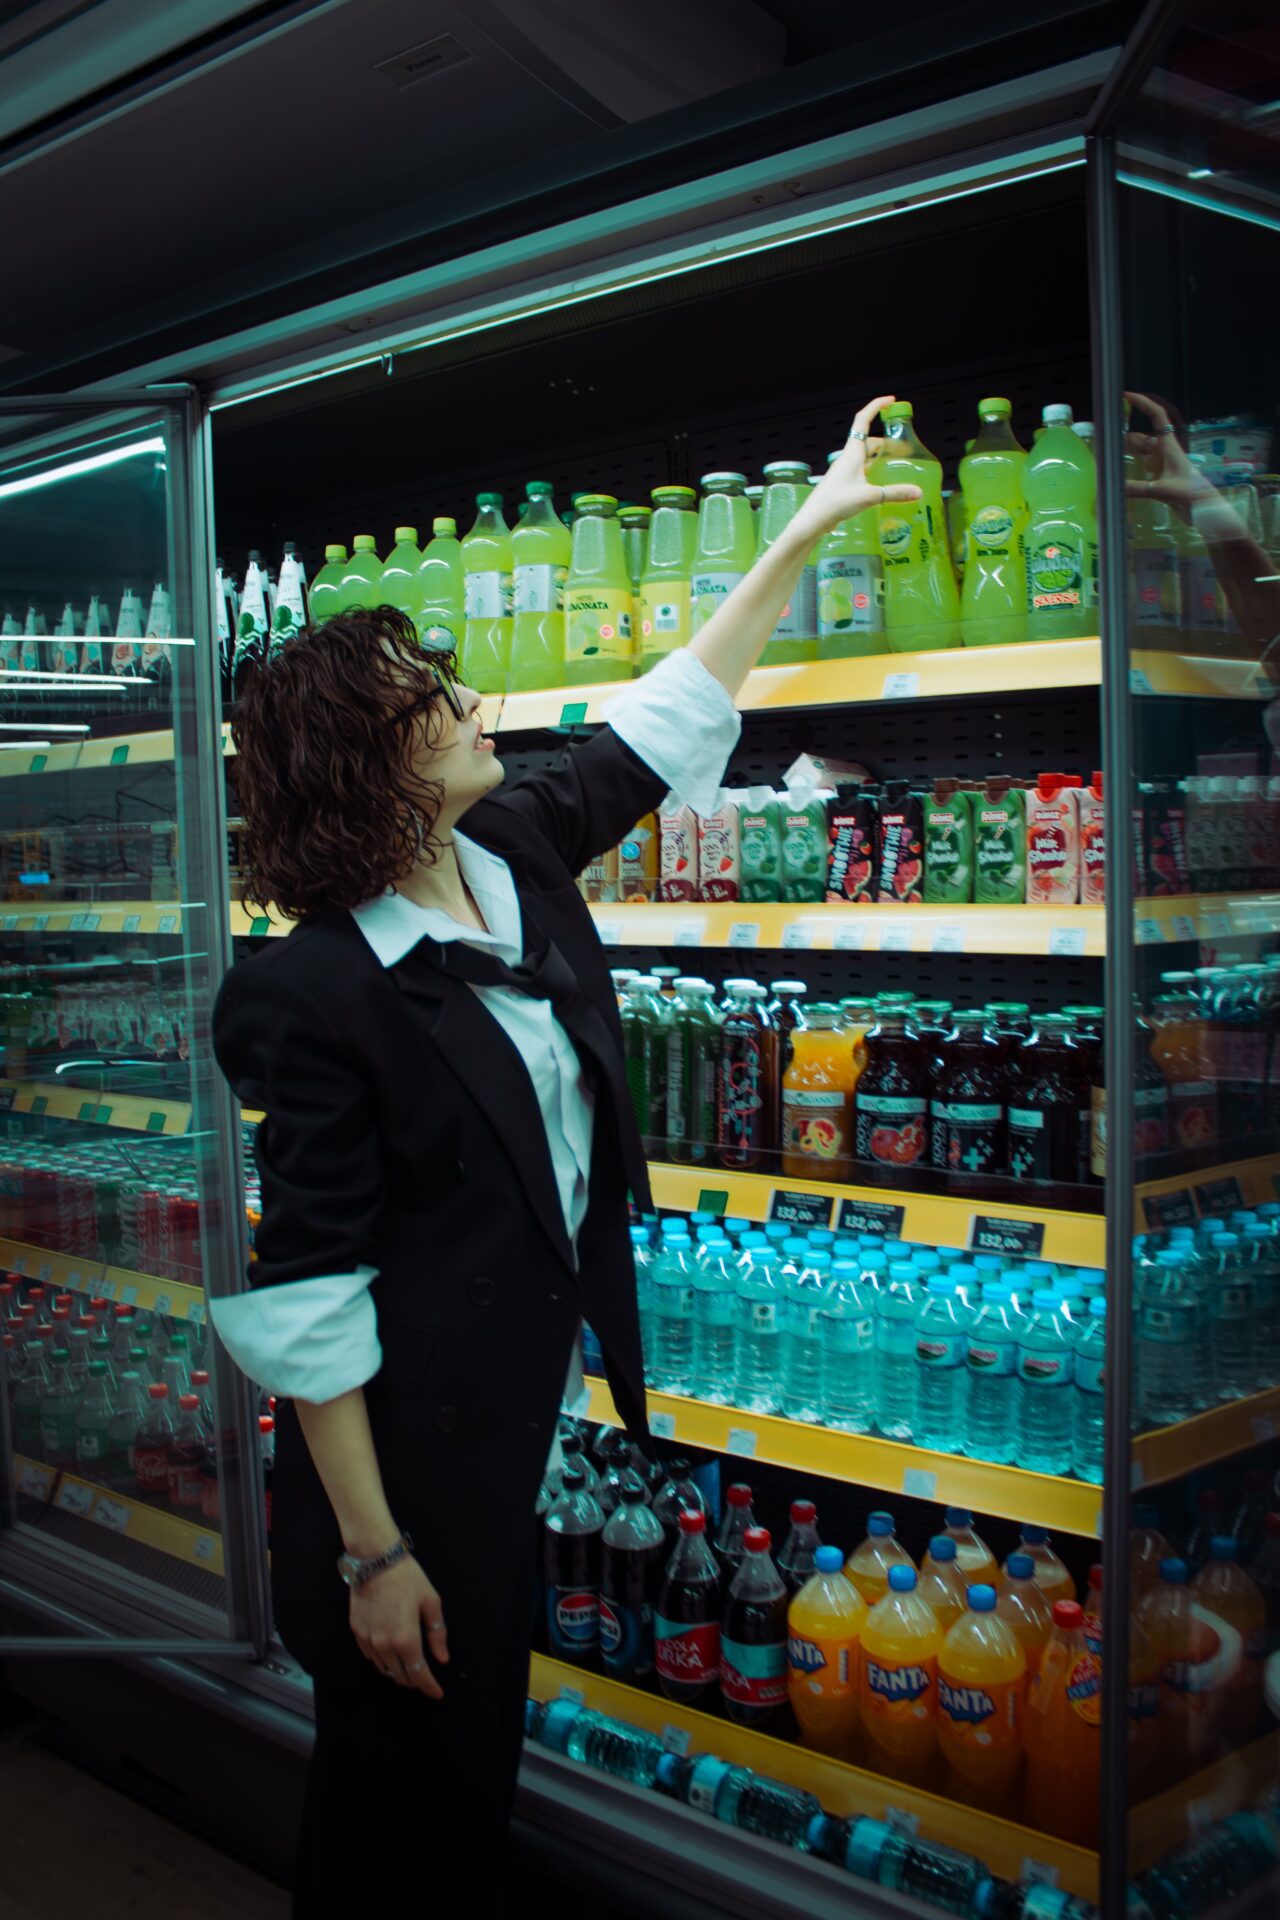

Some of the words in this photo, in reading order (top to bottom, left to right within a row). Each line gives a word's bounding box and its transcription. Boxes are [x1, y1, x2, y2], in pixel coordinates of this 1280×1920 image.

[829, 826, 853, 890] SMOOTHIE
[879, 825, 902, 890] SMOOTHIE
[867, 1662, 930, 1691] FANTA
